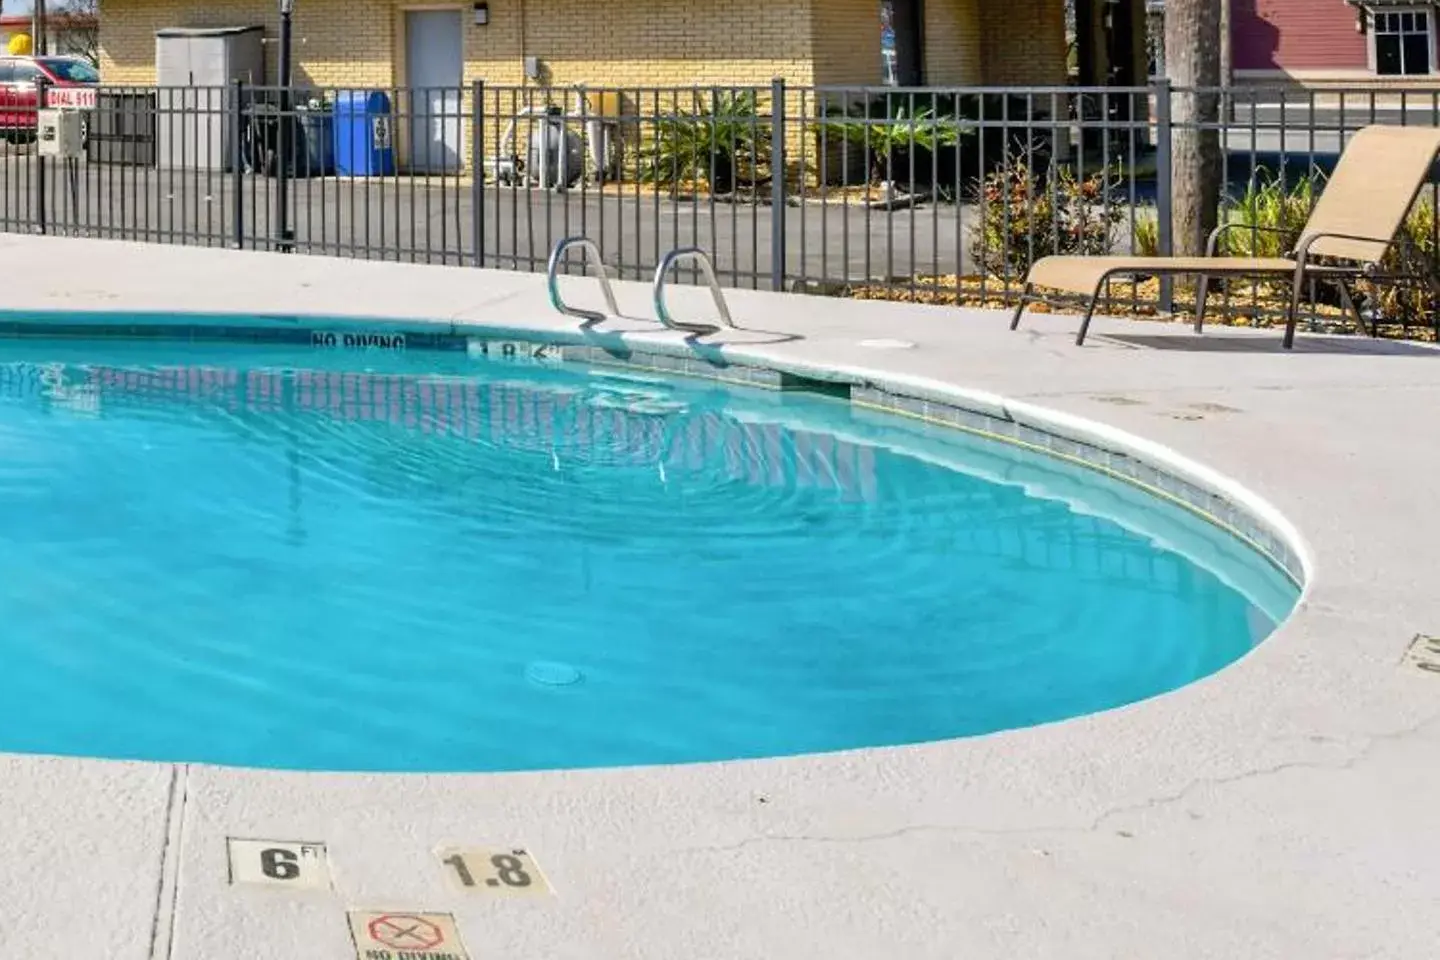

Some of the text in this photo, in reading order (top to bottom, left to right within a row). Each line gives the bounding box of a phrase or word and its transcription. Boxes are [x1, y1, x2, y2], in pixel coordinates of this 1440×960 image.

[51, 91, 73, 106] DIAL
[259, 847, 300, 880] 6
[442, 852, 532, 888] 1.8
